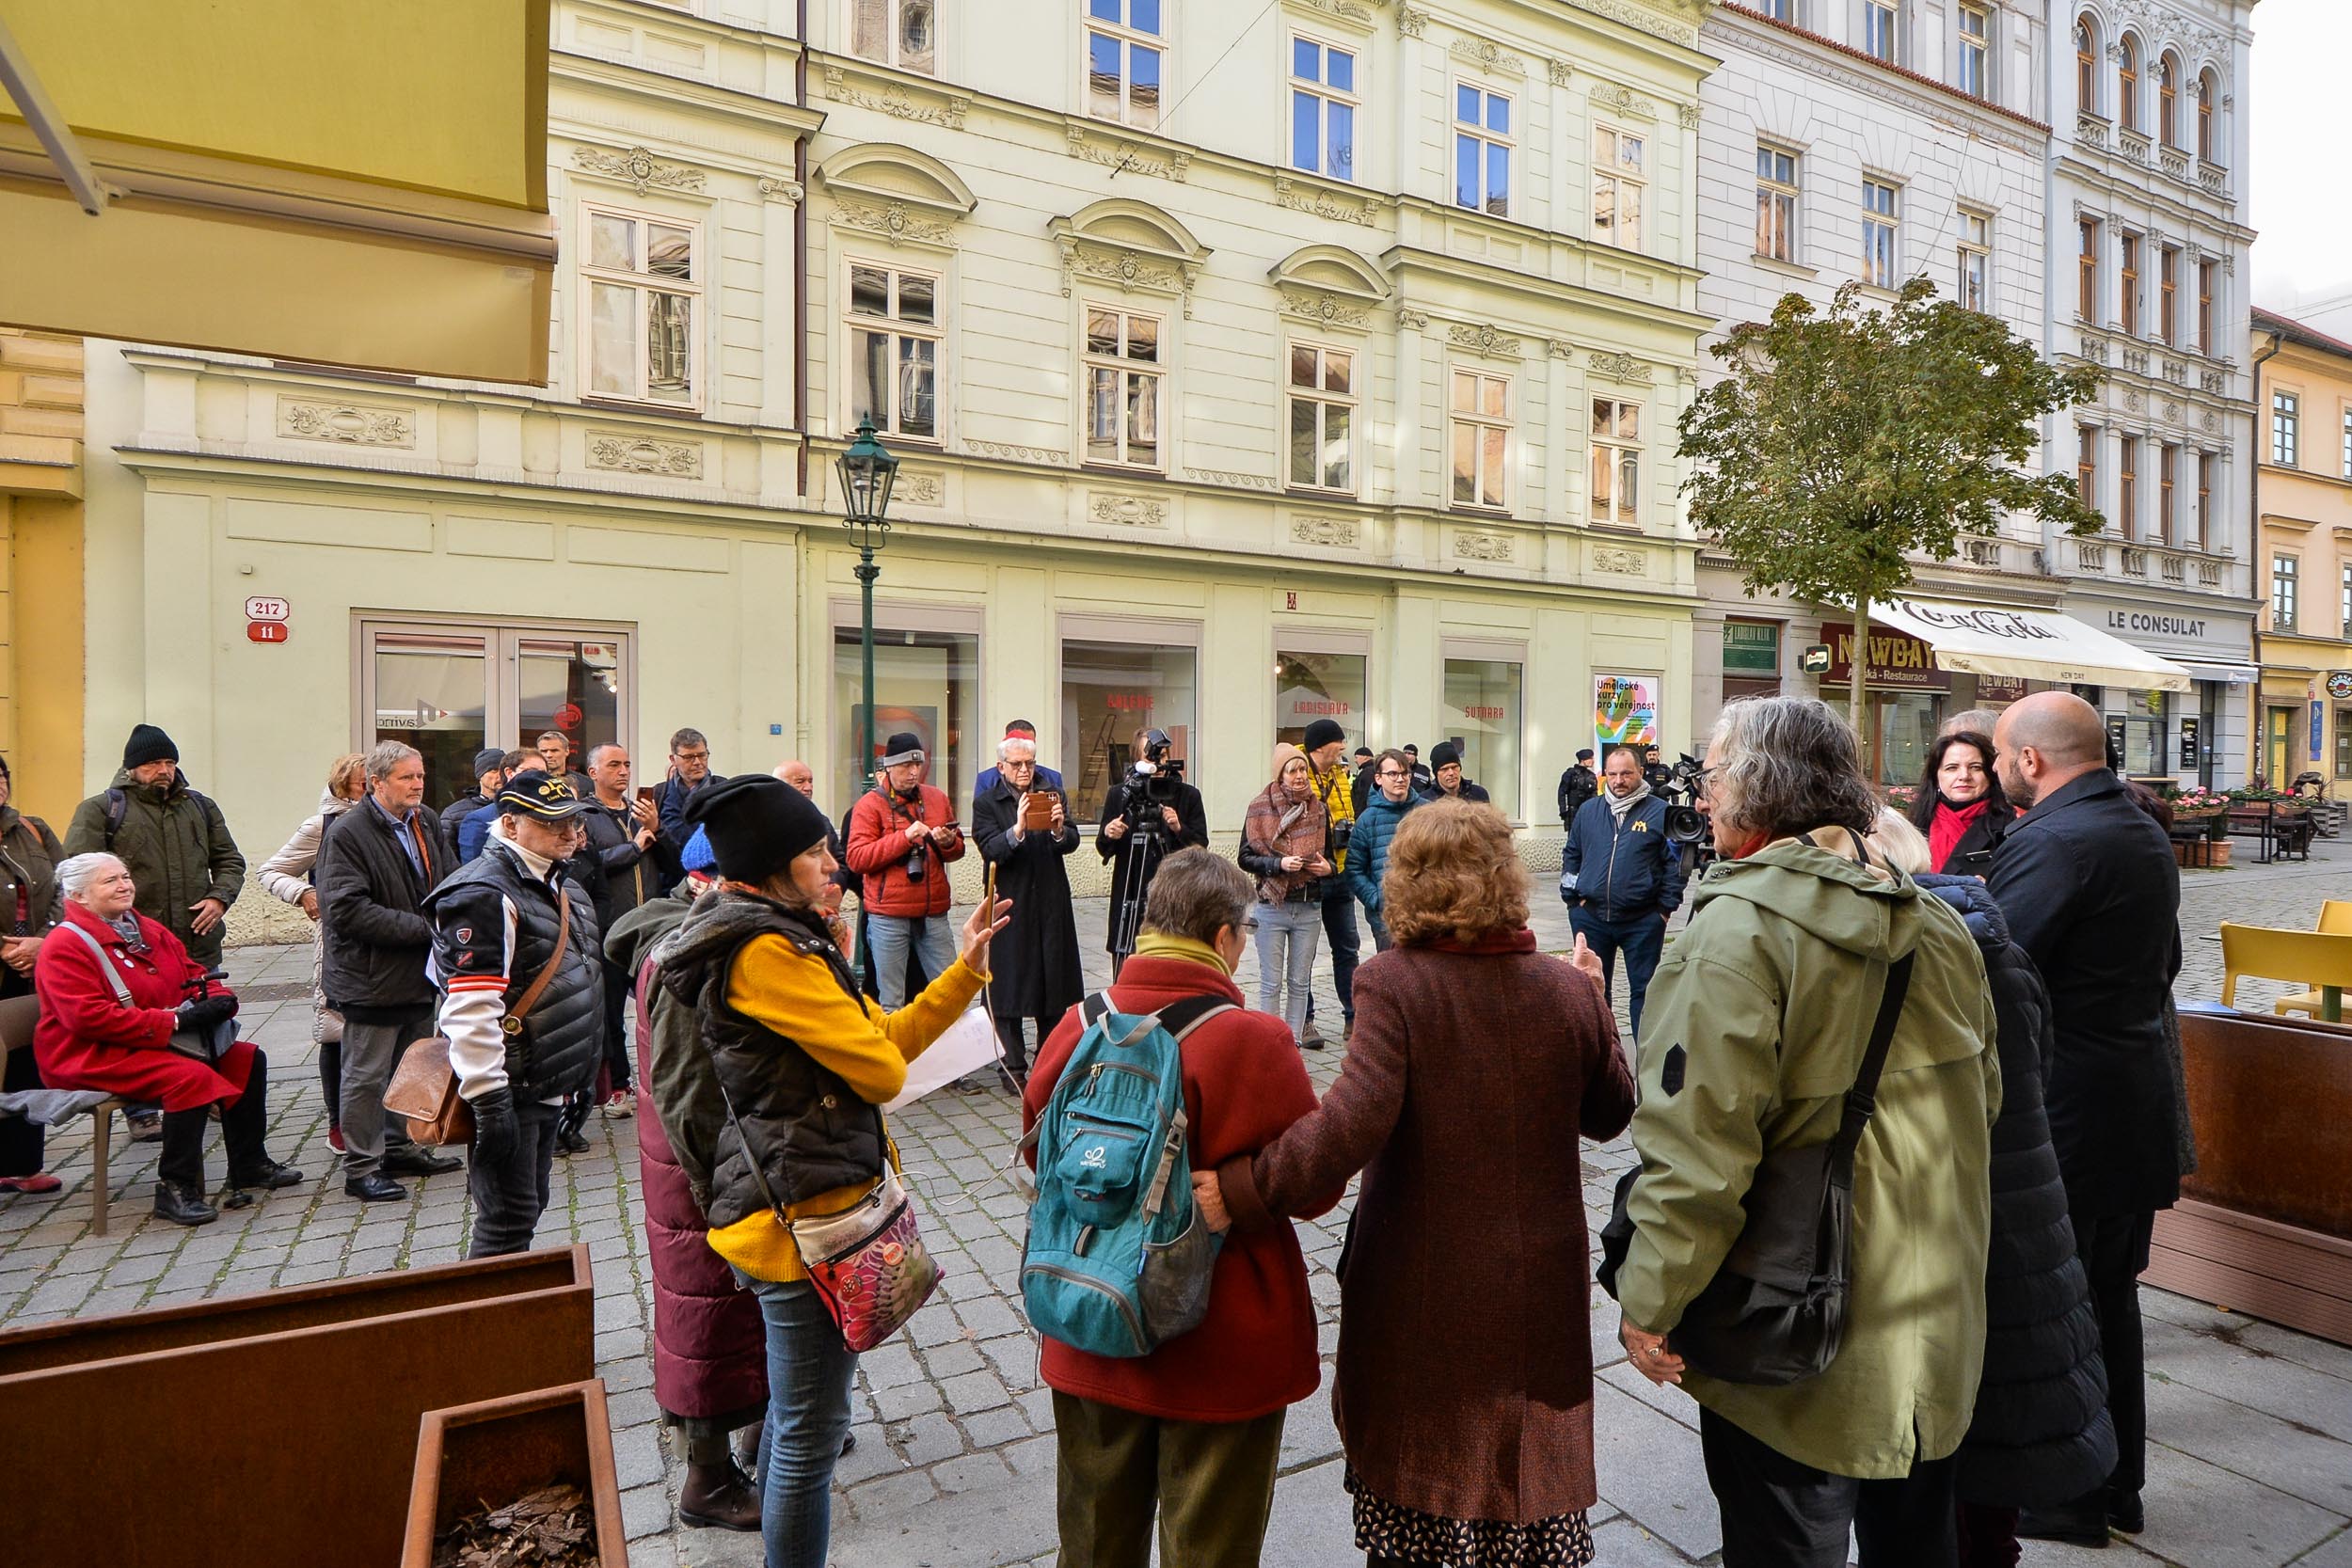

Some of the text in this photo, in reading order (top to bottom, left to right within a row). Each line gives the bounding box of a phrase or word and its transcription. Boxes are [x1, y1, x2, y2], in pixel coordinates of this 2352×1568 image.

[255, 602, 279, 615] 217
[2108, 610, 2205, 637] LE CONSULAT
[261, 626, 274, 639] 11
[1838, 633, 1935, 669] NWDAY
[1883, 670, 1928, 682] Restaurace
[1597, 678, 1639, 691] Umělecké
[1597, 689, 1622, 701] kurzy
[1294, 700, 1349, 715] LADISLAVA
[1465, 705, 1503, 720] SUTNARA
[1597, 700, 1656, 712] pro veřejnost
